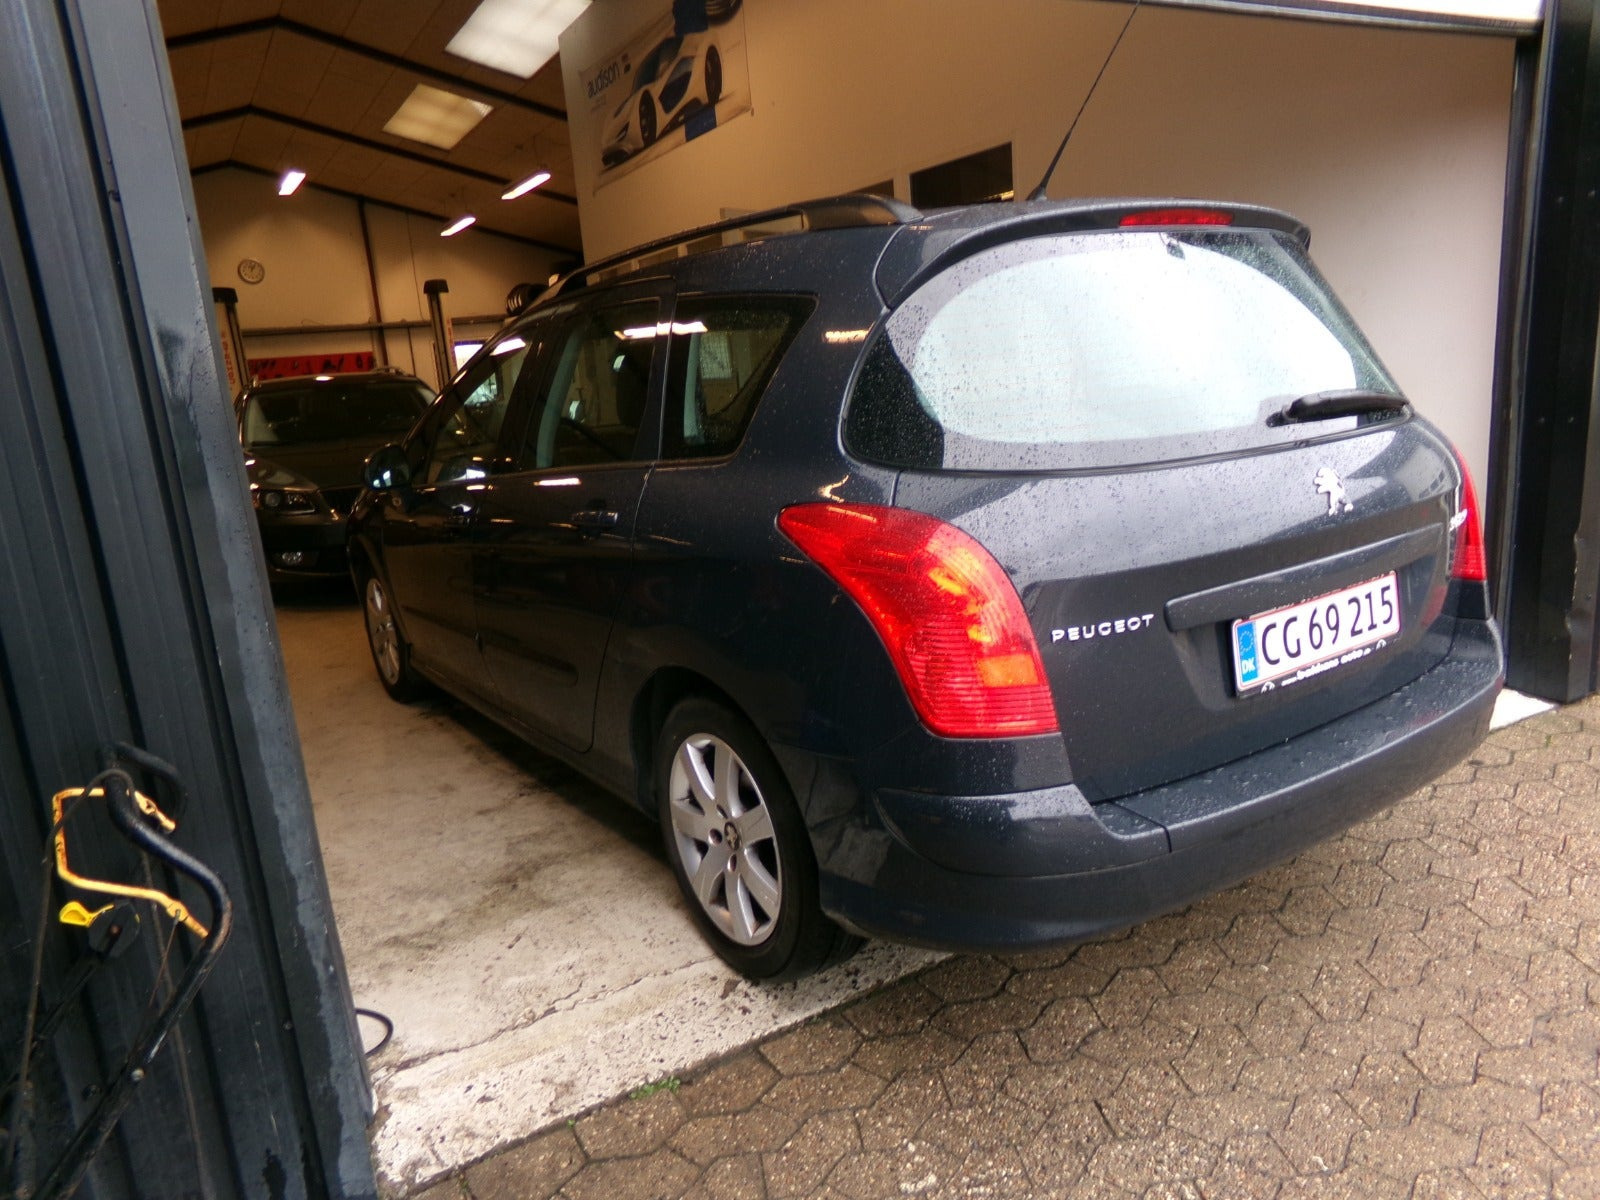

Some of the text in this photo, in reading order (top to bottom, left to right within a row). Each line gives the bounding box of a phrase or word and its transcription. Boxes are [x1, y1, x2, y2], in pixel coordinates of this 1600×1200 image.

[586, 61, 621, 98] audison
[1051, 613, 1154, 643] PEUGEOT
[1261, 585, 1393, 666] CG 69 215
[1241, 657, 1256, 674] DK
